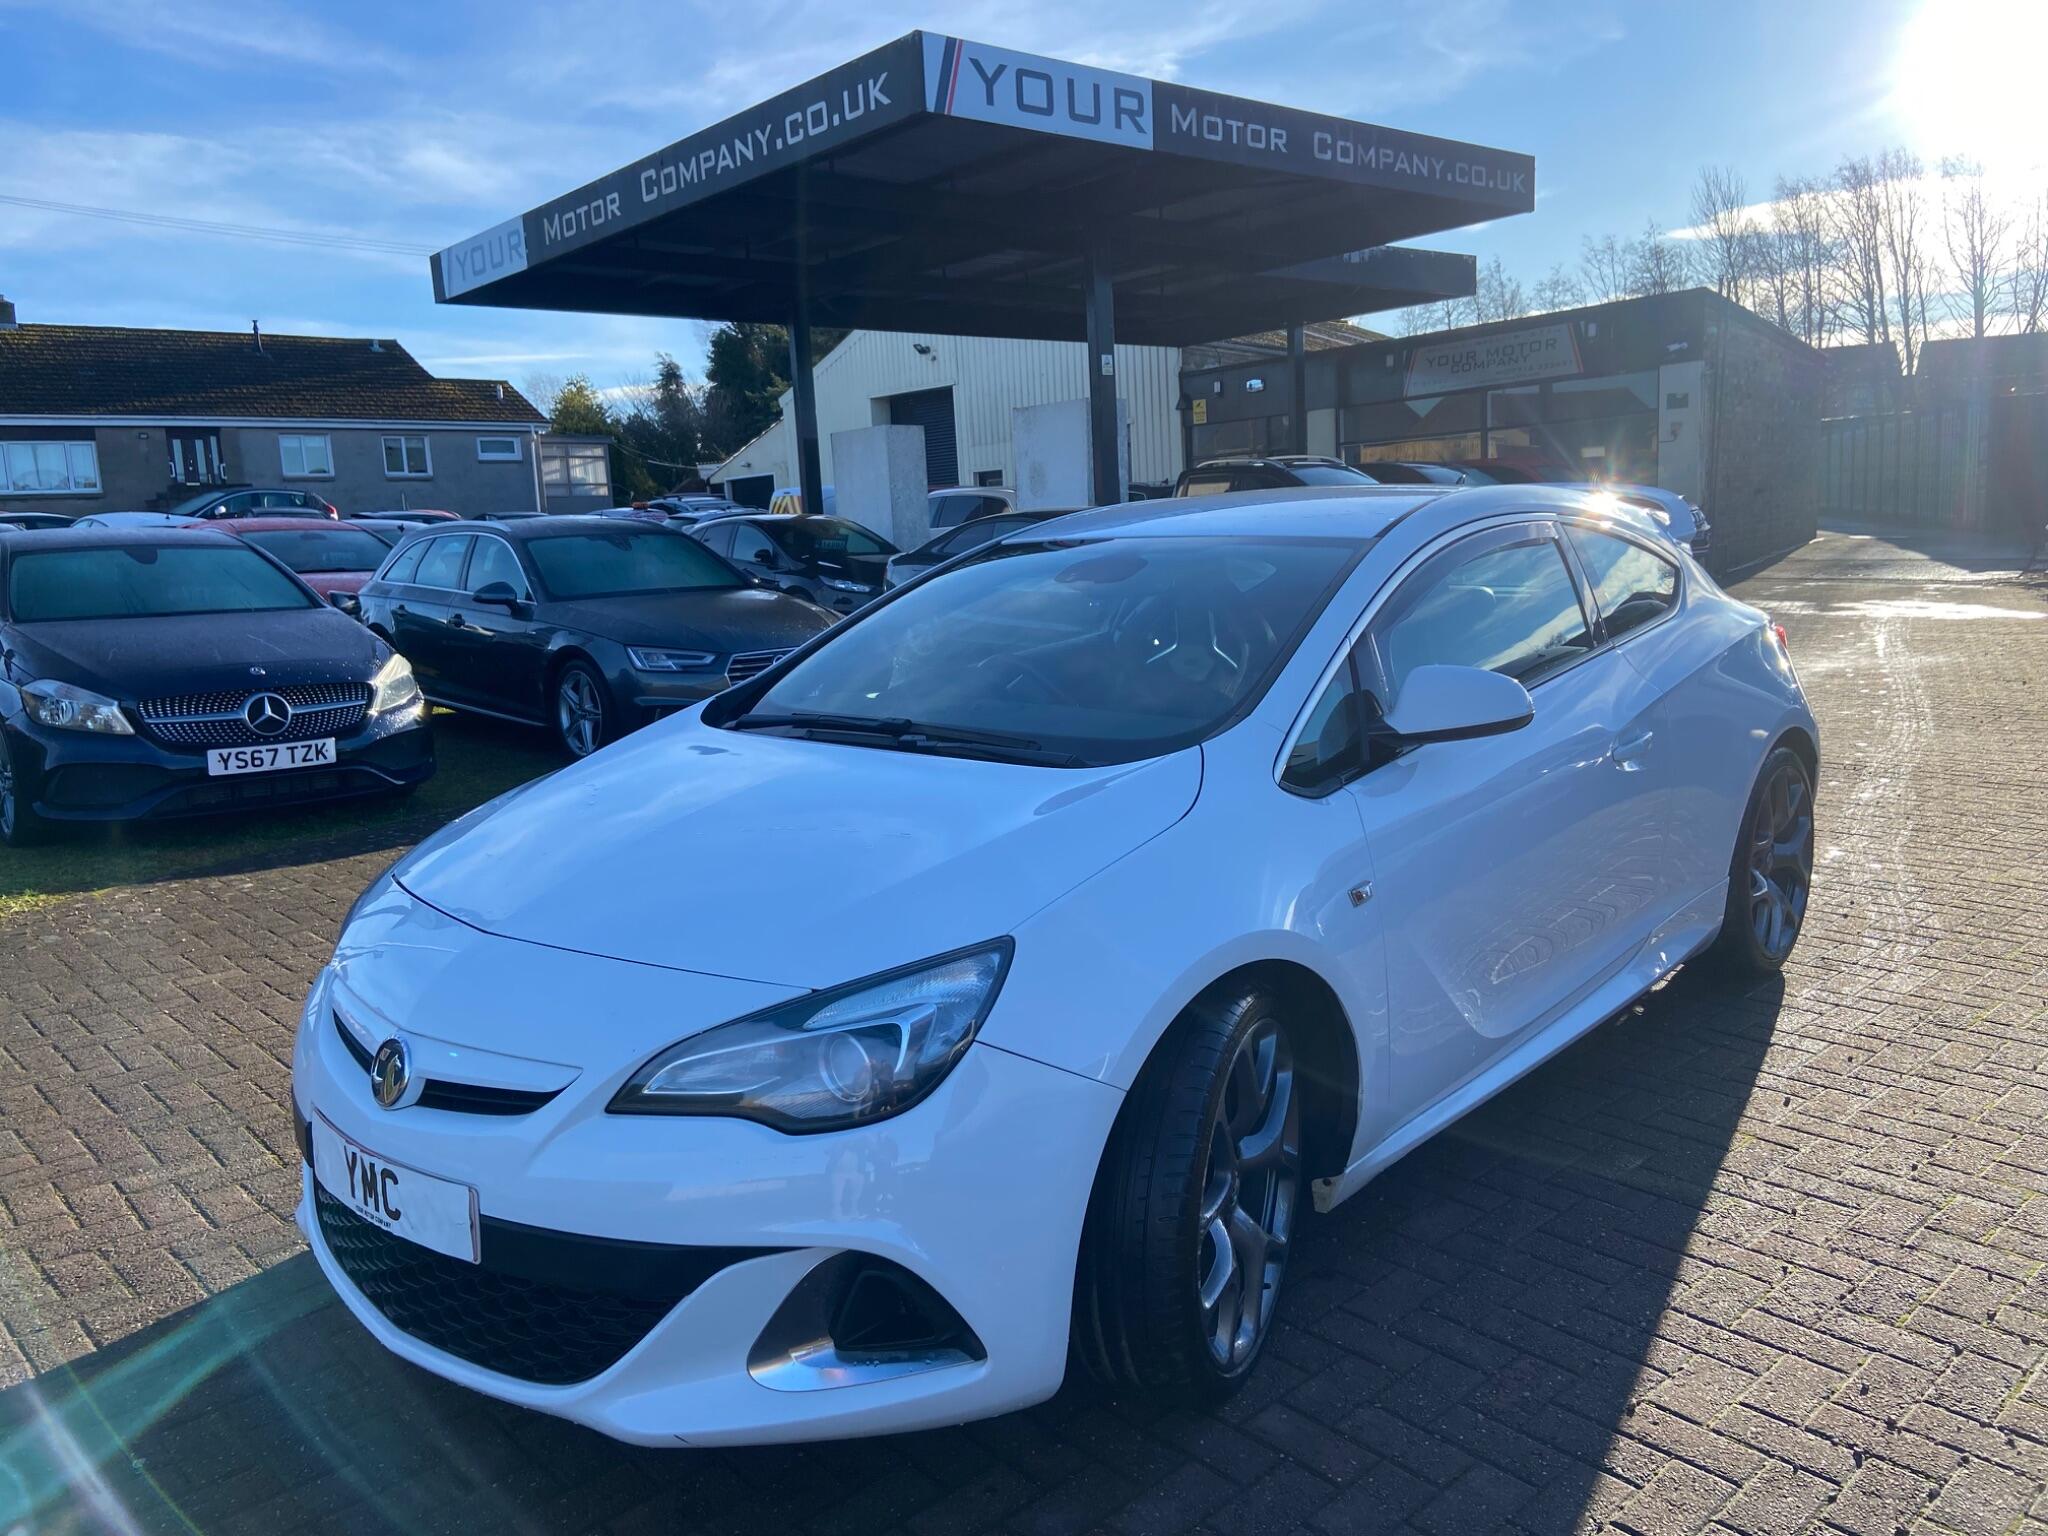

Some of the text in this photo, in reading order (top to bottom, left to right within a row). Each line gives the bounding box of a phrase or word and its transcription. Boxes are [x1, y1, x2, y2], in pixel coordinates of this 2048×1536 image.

[967, 56, 1526, 193] YOUR MOTOR COMPANY.CO.UK
[455, 71, 893, 281] YOUR MOTOR COMPANY.CO.UK
[1425, 350, 1477, 369] YOUR
[1486, 338, 1558, 360] MOTOR
[1450, 353, 1531, 374] COMPANY
[218, 742, 328, 771] YS67 TZK
[343, 1145, 402, 1222] YMC
